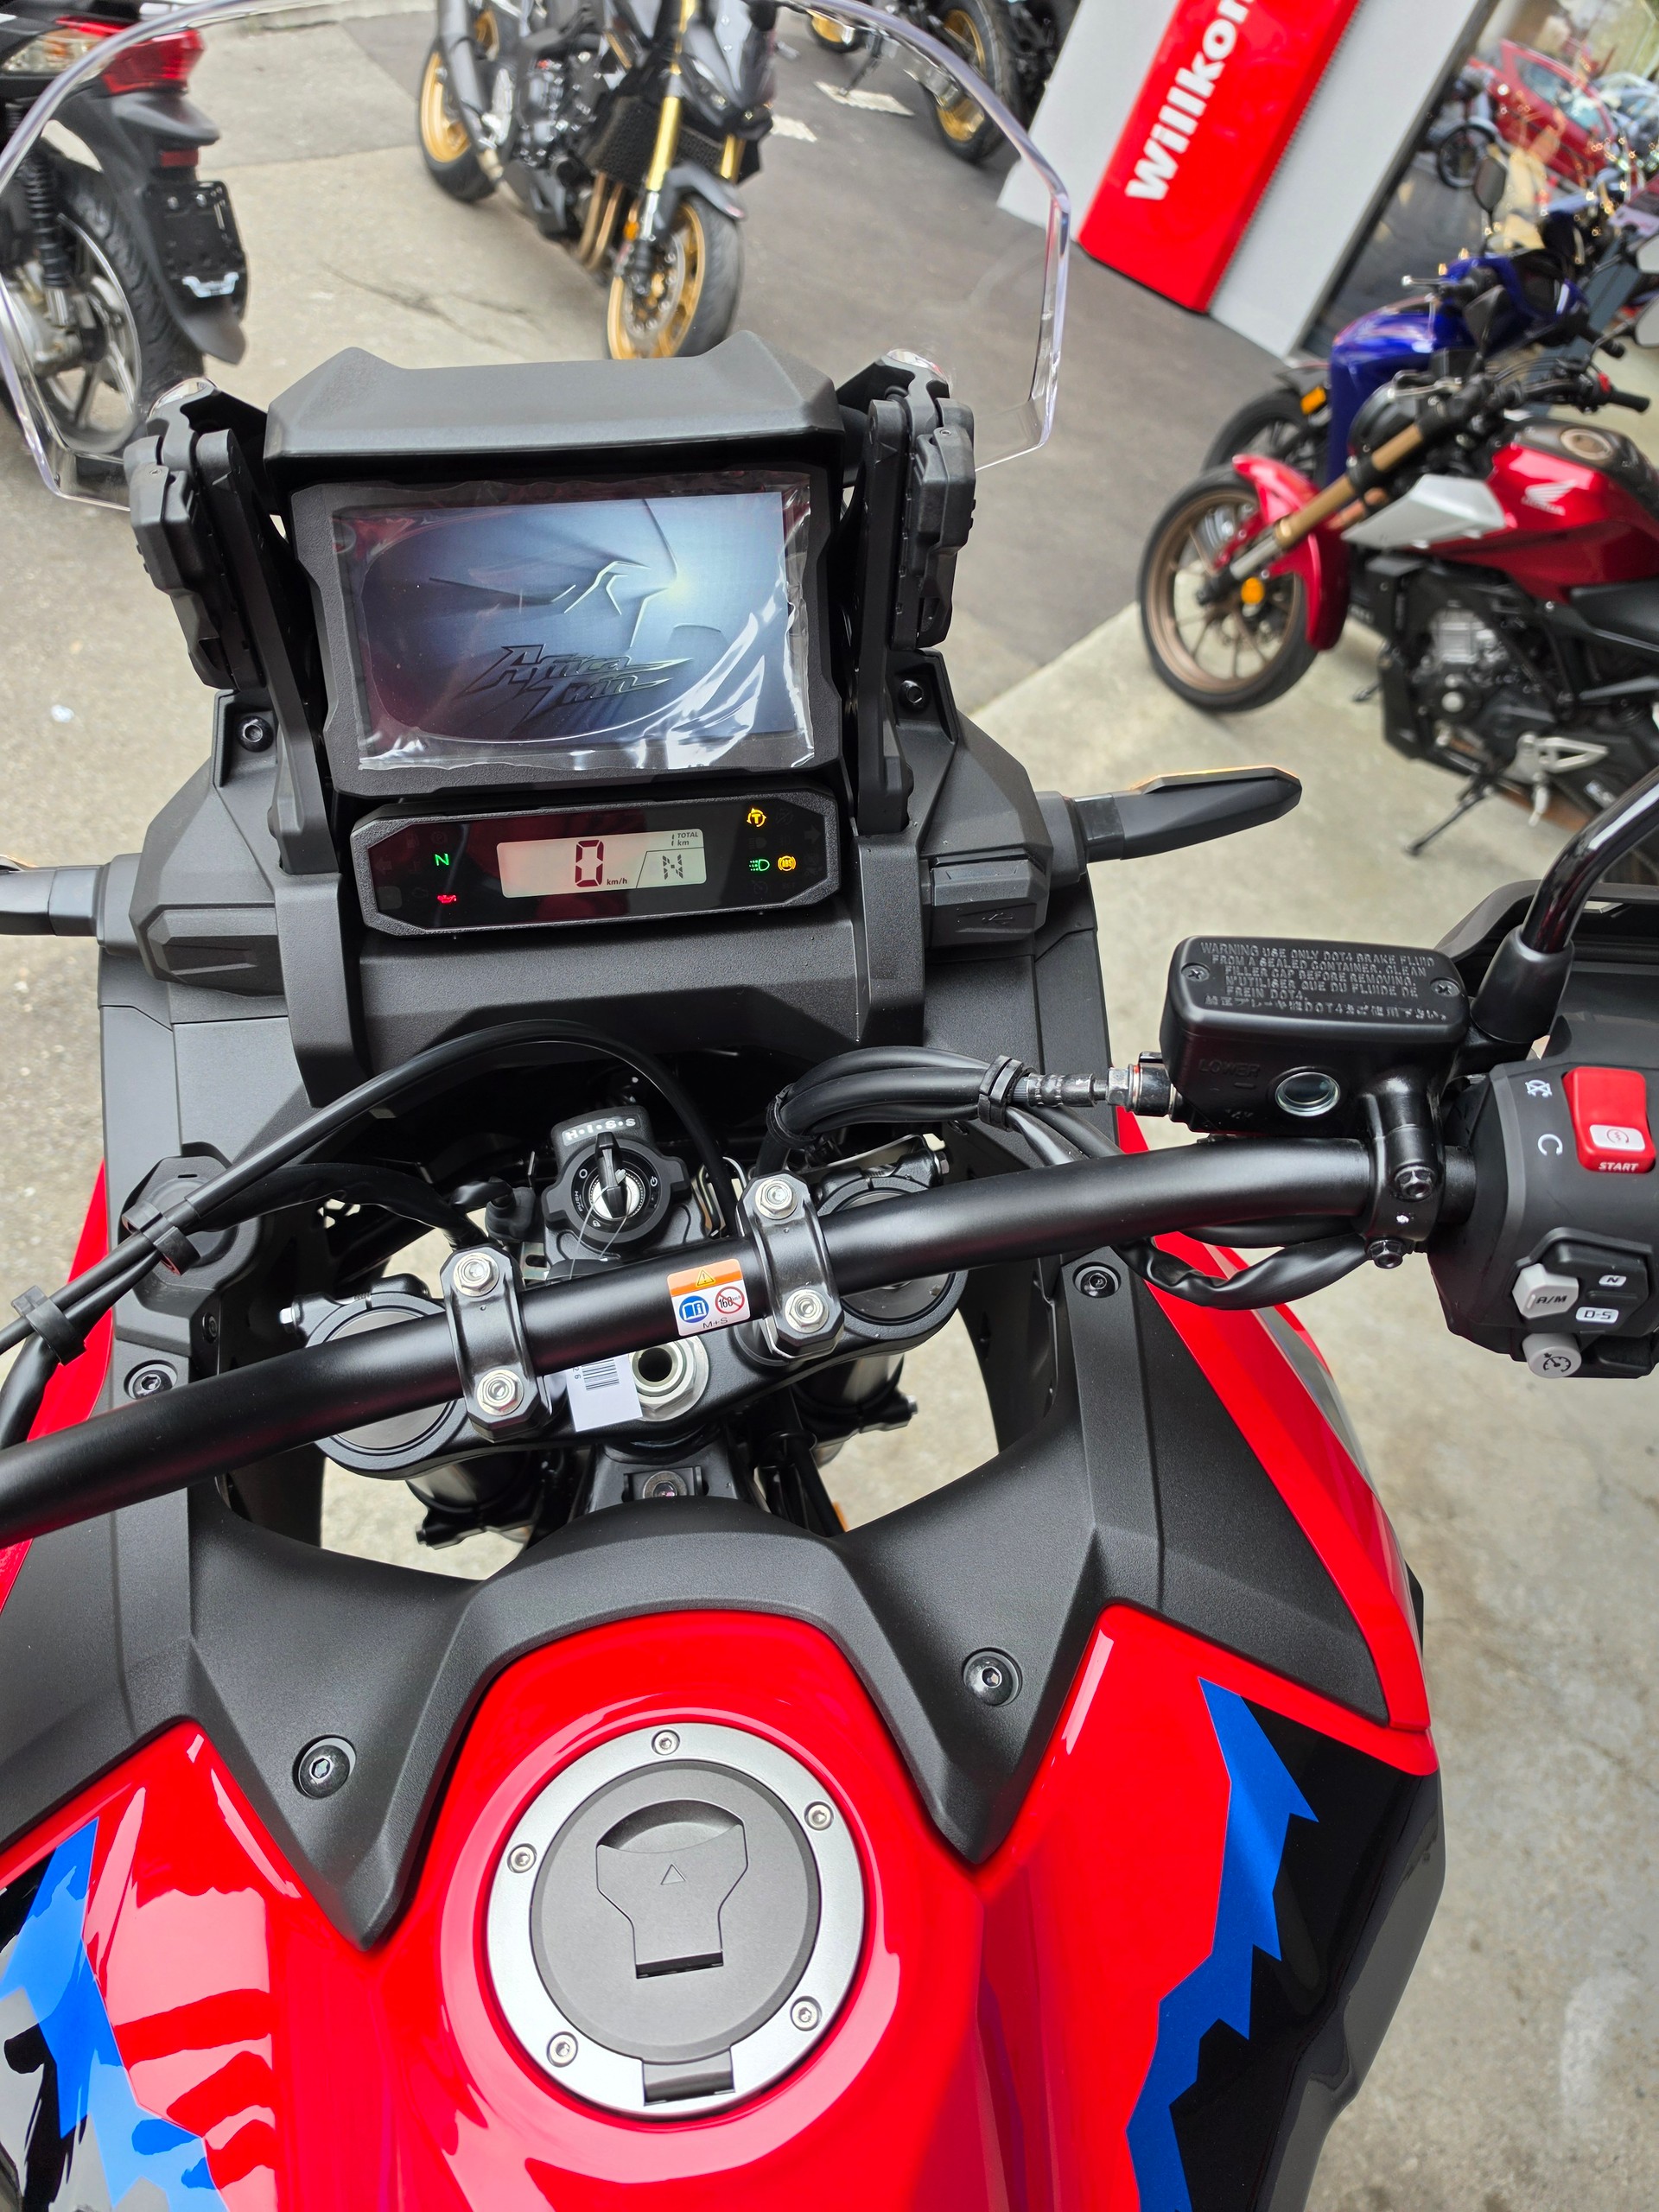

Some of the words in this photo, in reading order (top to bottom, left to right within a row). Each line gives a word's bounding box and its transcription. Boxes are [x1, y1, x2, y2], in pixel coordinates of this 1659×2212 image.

[434, 853, 450, 867] N
[575, 839, 605, 888] 0
[606, 877, 628, 886] km/h
[1200, 942, 1260, 957] WARNING
[1262, 947, 1286, 958] USE
[1290, 949, 1319, 960] ONLY
[1323, 950, 1353, 962] DOT4
[1356, 953, 1396, 965] BRAKE
[1399, 955, 1435, 968] FLUID
[1211, 954, 1245, 966] FROM
[1248, 956, 1256, 966] A
[1259, 957, 1308, 969] SEALED
[1311, 960, 1382, 975] CONTAINER.
[1385, 964, 1427, 977] CLEAN
[1225, 965, 1268, 977] FILLER
[1271, 968, 1295, 979] CAP
[1298, 969, 1347, 983] BEFORE
[1350, 972, 1416, 987] REMOVING.
[1226, 986, 1265, 999] FREIN
[1300, 980, 1326, 992] QUE
[1330, 982, 1348, 993] DU
[1351, 982, 1397, 996] FLUIDE
[1401, 986, 1419, 998] DE
[1198, 1058, 1262, 1078] LOWER
[1598, 1161, 1639, 1173] START
[1535, 1295, 1568, 1305] A/M
[1583, 1309, 1612, 1320] D-S
[702, 1316, 728, 1329] M+S
